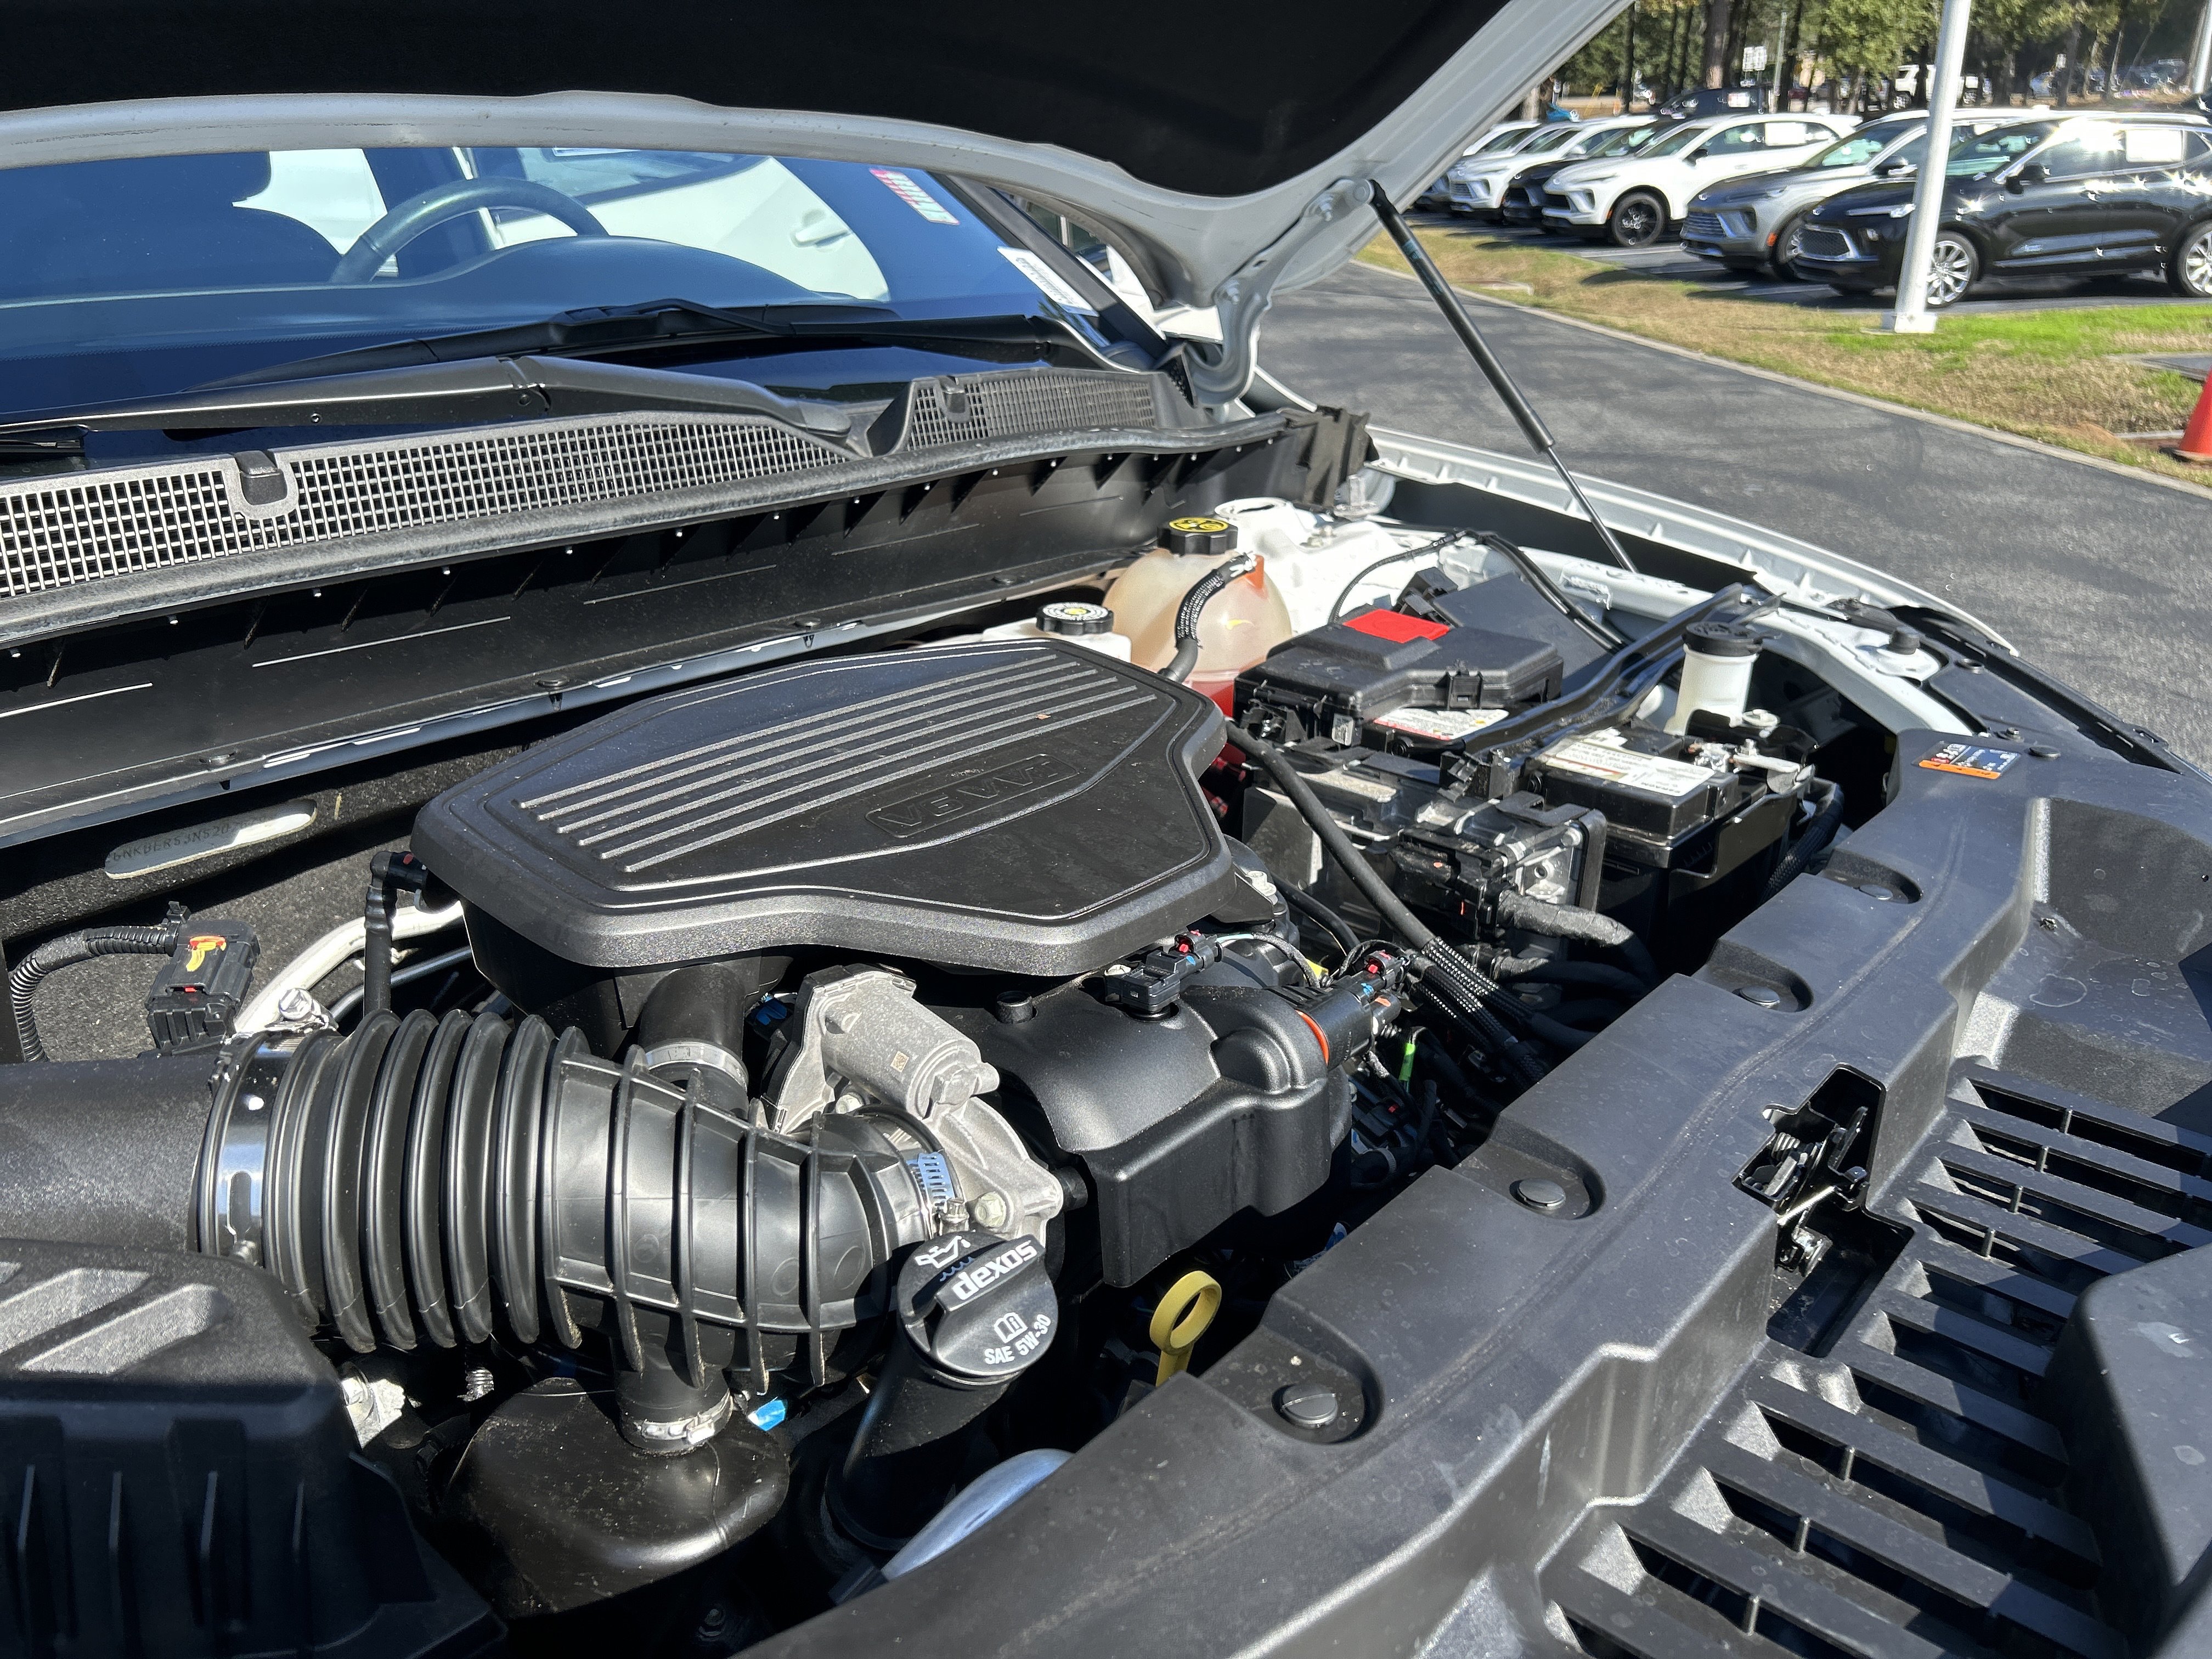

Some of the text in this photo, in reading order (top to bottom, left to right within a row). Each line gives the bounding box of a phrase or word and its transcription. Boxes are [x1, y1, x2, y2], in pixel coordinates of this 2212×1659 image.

[952, 1240, 1037, 1300] dexos
[984, 1314, 1052, 1364] SAE 5W-30
